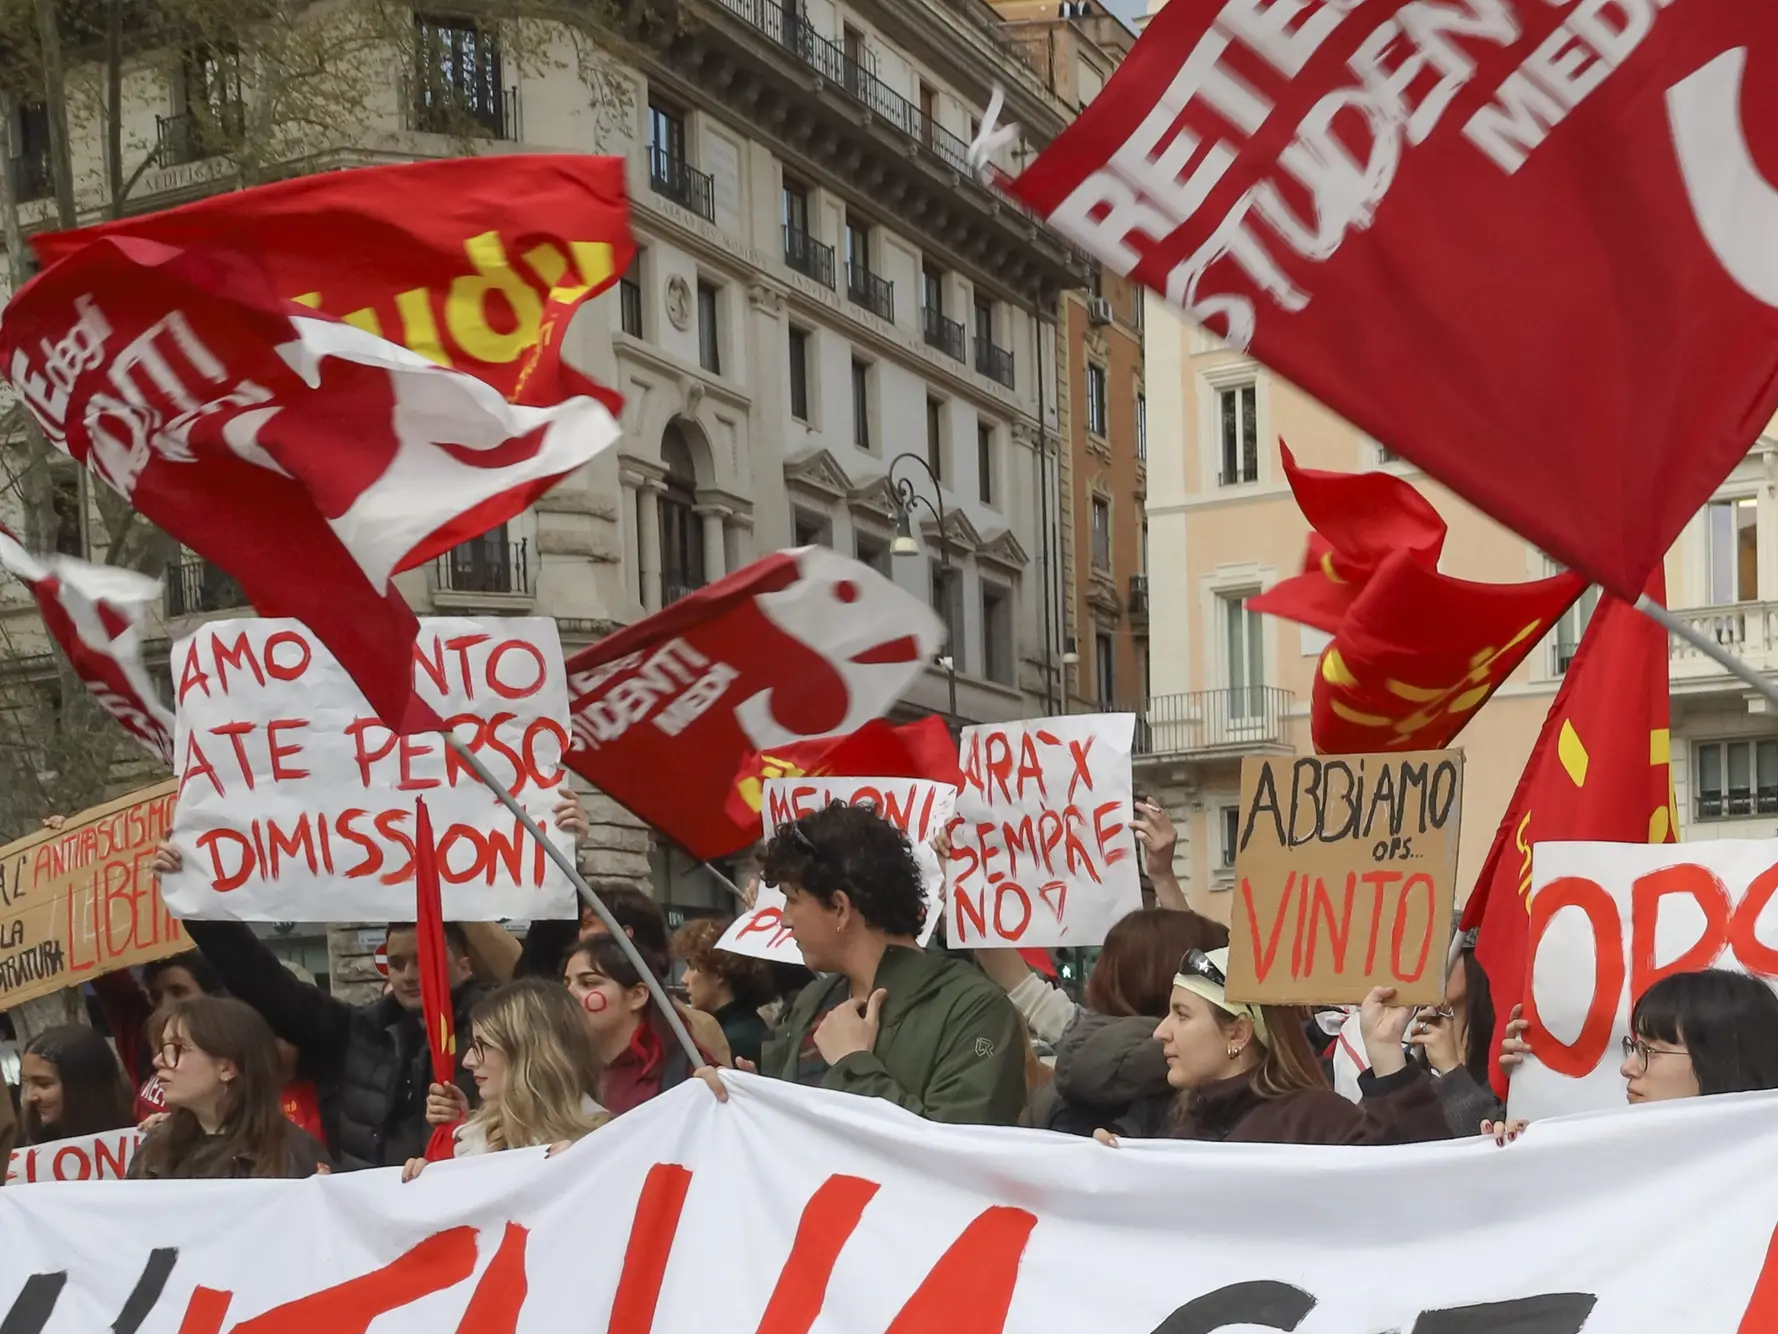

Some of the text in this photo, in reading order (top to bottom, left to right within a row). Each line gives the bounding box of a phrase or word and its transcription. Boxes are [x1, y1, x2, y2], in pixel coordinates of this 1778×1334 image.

[1461, 0, 1674, 176] MED
[1166, 0, 1540, 355] STUDEN
[343, 711, 573, 805] PERSO
[195, 804, 547, 893] DIMISSONI
[769, 783, 937, 844] MEONI
[945, 800, 1130, 886] SEMPRE
[1241, 869, 1436, 985] VINTO
